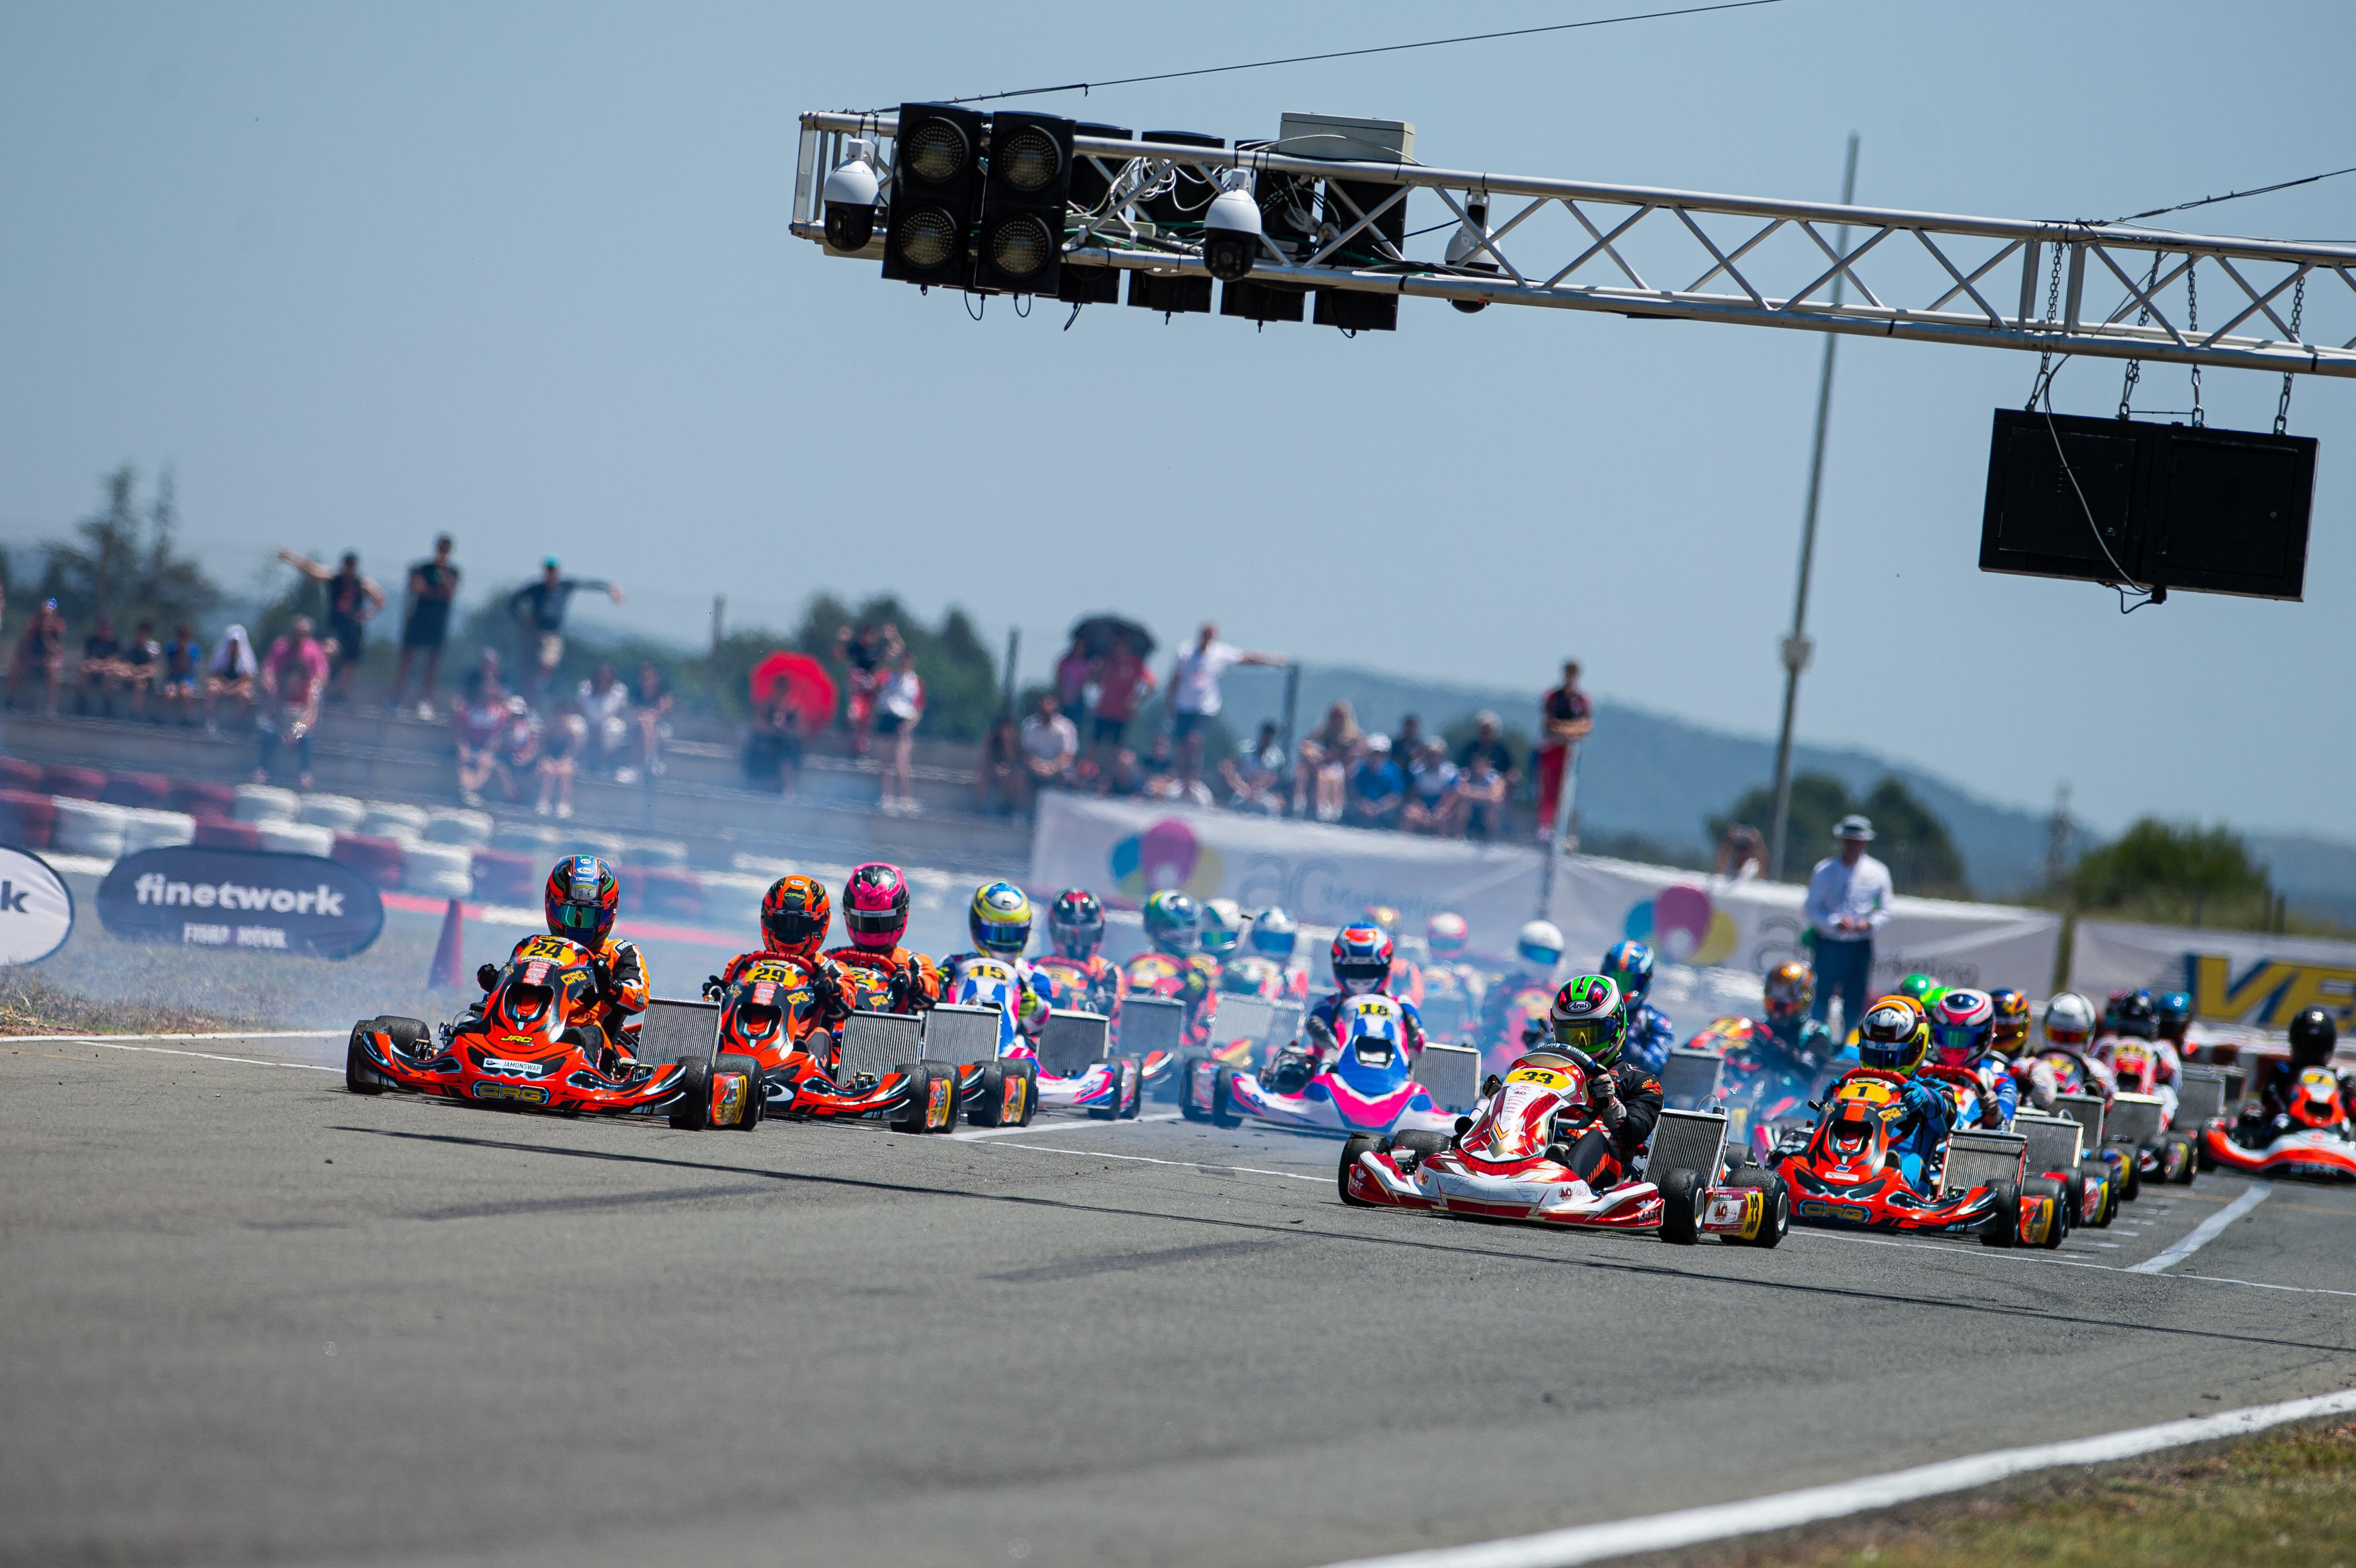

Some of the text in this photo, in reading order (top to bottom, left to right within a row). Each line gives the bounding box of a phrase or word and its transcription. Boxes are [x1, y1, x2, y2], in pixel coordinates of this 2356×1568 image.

[134, 872, 346, 917] finetwork
[529, 943, 564, 958] 24
[561, 970, 587, 985] CRG
[754, 969, 786, 983] 29
[970, 965, 1006, 980] 15
[787, 991, 809, 1004] CRG
[1362, 1004, 1388, 1016] 18
[502, 1061, 541, 1072] JAMONSWAP
[1518, 1071, 1555, 1084] 33
[479, 1084, 542, 1102] CRG
[1856, 1086, 1868, 1097] 1
[1638, 1210, 1659, 1221] KART
[1745, 1194, 1760, 1233] 33
[1805, 1204, 1864, 1220] CRG
